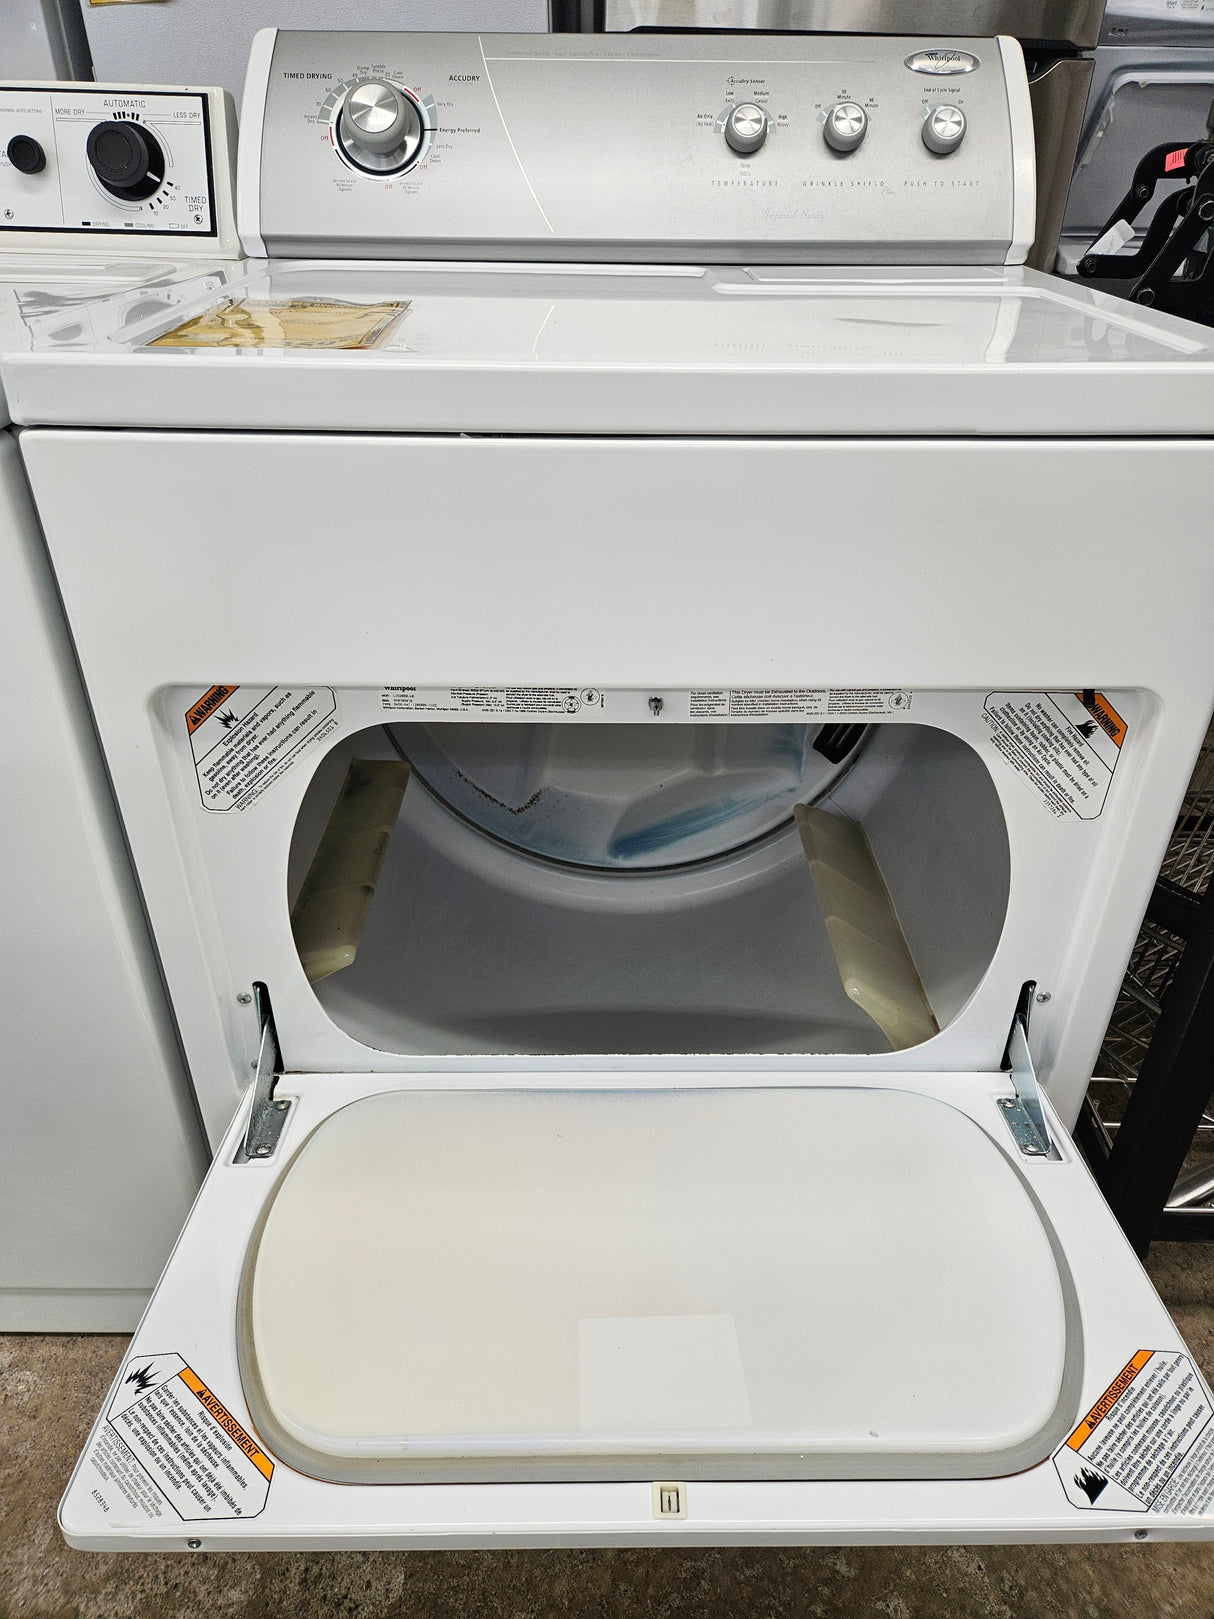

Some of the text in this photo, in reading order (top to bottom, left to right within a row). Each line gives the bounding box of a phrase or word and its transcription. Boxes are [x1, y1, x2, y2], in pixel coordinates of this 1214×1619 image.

[925, 52, 961, 63] Whirlpool
[103, 99, 146, 108] AUTOMATIC
[184, 196, 207, 204] TIMED
[189, 204, 203, 212] DRY
[193, 685, 229, 721] WARNING
[1089, 703, 1120, 737] WARNING
[202, 767, 215, 777] Keep
[212, 748, 234, 768] flammable
[233, 730, 253, 748] materials
[251, 721, 261, 731] and
[274, 697, 286, 709] such
[211, 782, 220, 790] not
[226, 760, 244, 777] anything
[242, 751, 252, 760] that
[249, 744, 259, 753] has
[258, 735, 268, 745] ever
[266, 727, 277, 737] had
[275, 711, 295, 729] anything
[292, 690, 315, 712] flammable
[222, 712, 259, 746] Explosion Hazard
[226, 782, 242, 795] Failure
[244, 766, 258, 778] follow
[256, 756, 270, 767] these
[267, 733, 293, 757] instructions
[292, 726, 301, 734] can
[299, 714, 313, 726] result
[226, 754, 238, 765] away
[235, 745, 247, 755] from
[219, 780, 232, 791] (even
[231, 771, 241, 781] after
[244, 769, 264, 788] explosion
[235, 789, 259, 809] WARNING:
[1090, 1363, 1138, 1423] AVERTISSEMENT
[202, 1395, 260, 1457] AVERTISSEMENT
[101, 1424, 135, 1466] AVERTISSEMENT:
